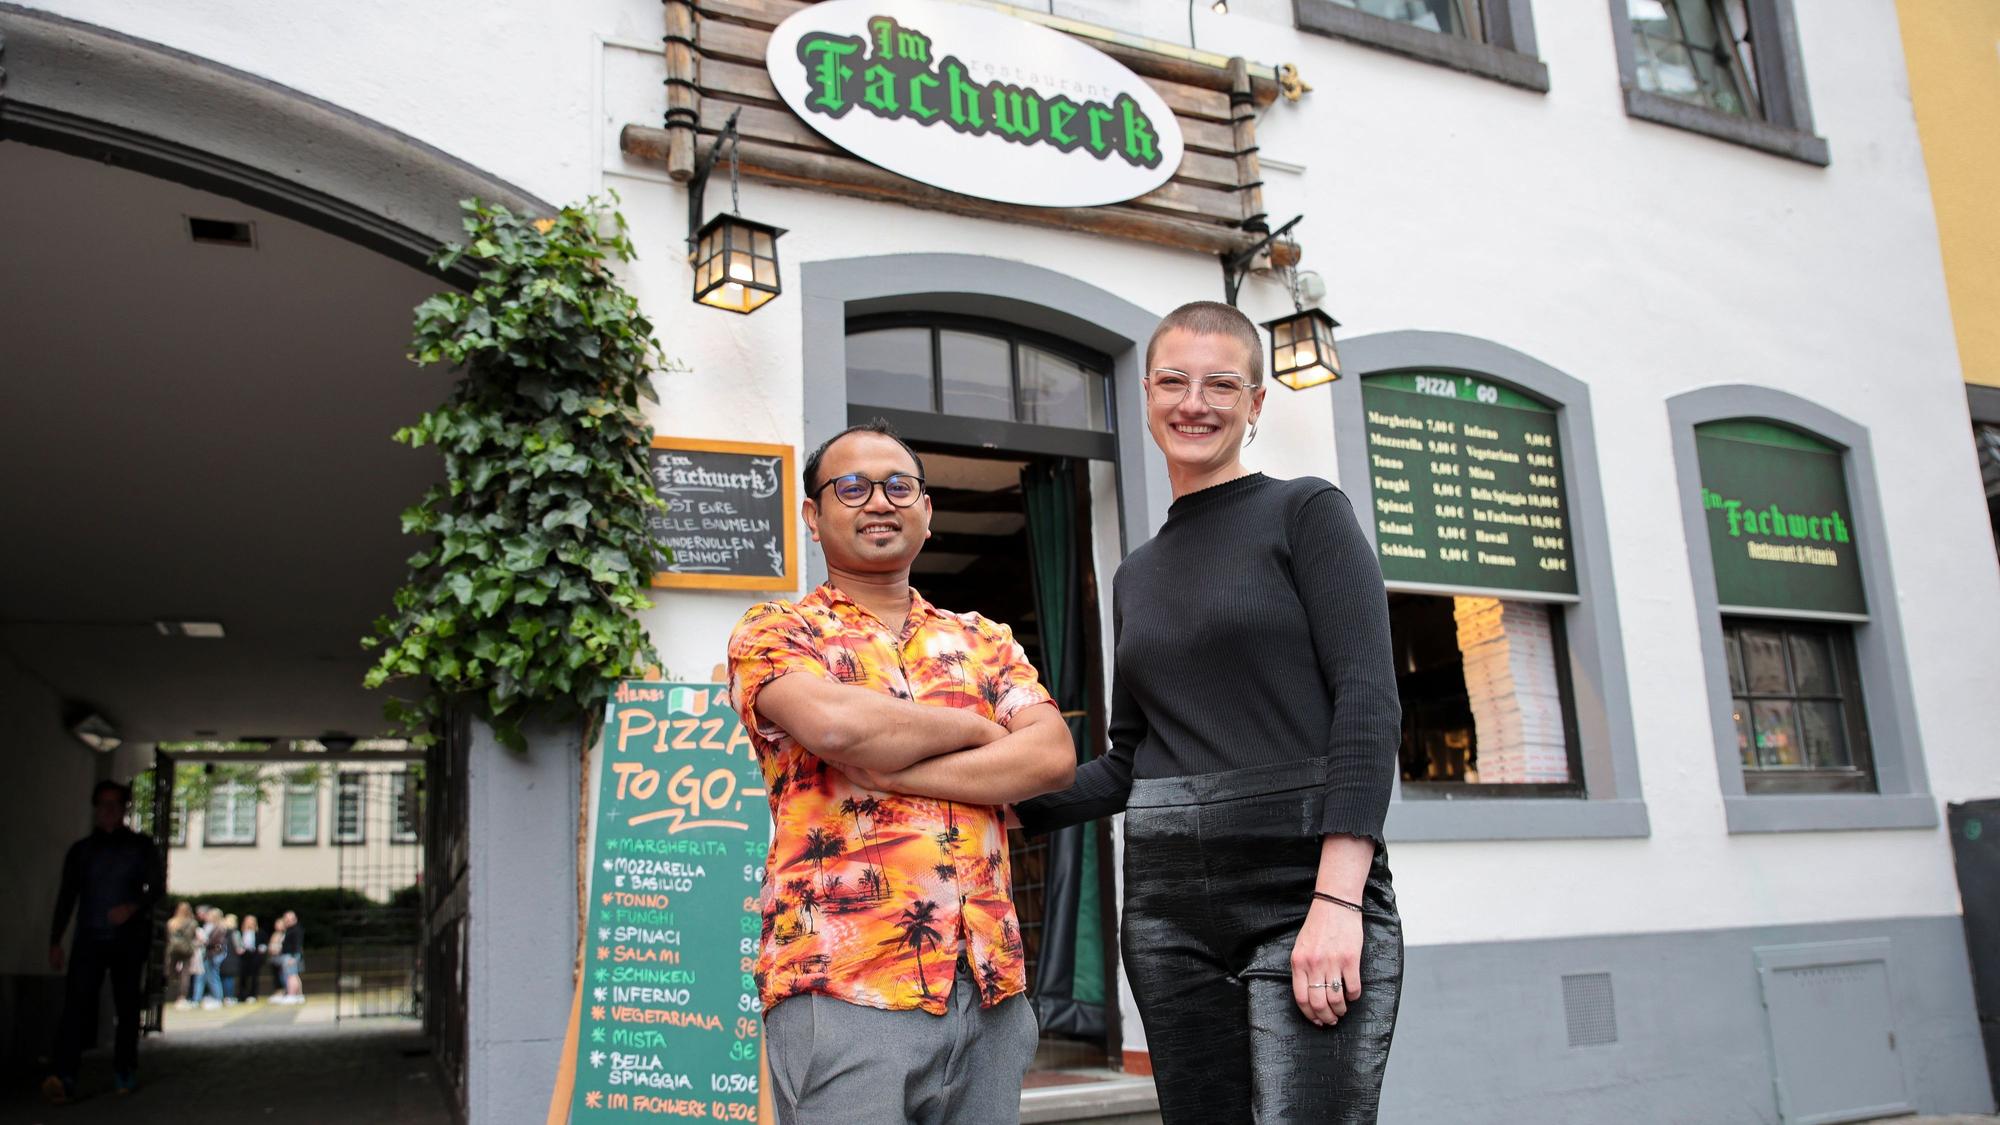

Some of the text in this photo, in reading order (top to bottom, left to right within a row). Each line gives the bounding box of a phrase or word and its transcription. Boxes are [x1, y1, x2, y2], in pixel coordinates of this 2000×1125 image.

[870, 19, 930, 63] Im
[970, 59, 1111, 98] restaurant
[803, 38, 1157, 162] Fachwerk
[1415, 375, 1456, 398] PIZZA
[1476, 384, 1498, 404] GO
[1368, 410, 1424, 430] Margherita
[1370, 433, 1424, 451] Mozzarella
[1372, 454, 1404, 470] Tonno
[653, 466, 767, 490] Fachwerk
[1375, 476, 1410, 494] Funghi
[1377, 498, 1414, 514] Spinaci
[702, 518, 770, 532] BAUMELN
[1379, 520, 1414, 536] Salami
[1723, 499, 1849, 543] Fachwerk
[1381, 542, 1426, 559] Schinken
[1478, 551, 1516, 567] Pommes
[617, 707, 759, 761] PIZZA
[612, 762, 660, 801] TO
[620, 838, 728, 856] MARGHERITA
[614, 857, 706, 877] MOZZARELLA
[615, 875, 693, 892] E BASILICO
[614, 892, 670, 910] TONNO
[617, 909, 674, 926] FUNGHI
[613, 926, 681, 946] SPINACI
[611, 966, 696, 984] SCHINKEN
[612, 986, 691, 1006] INFERNO
[610, 1005, 758, 1040] VEGETARIANA 9€
[612, 1029, 757, 1061] MISTA 9€
[609, 1051, 664, 1070] BELLA
[608, 1070, 693, 1090] SPIAGGIA
[607, 1093, 628, 1110] IM
[633, 1094, 707, 1119] FACHWERK
